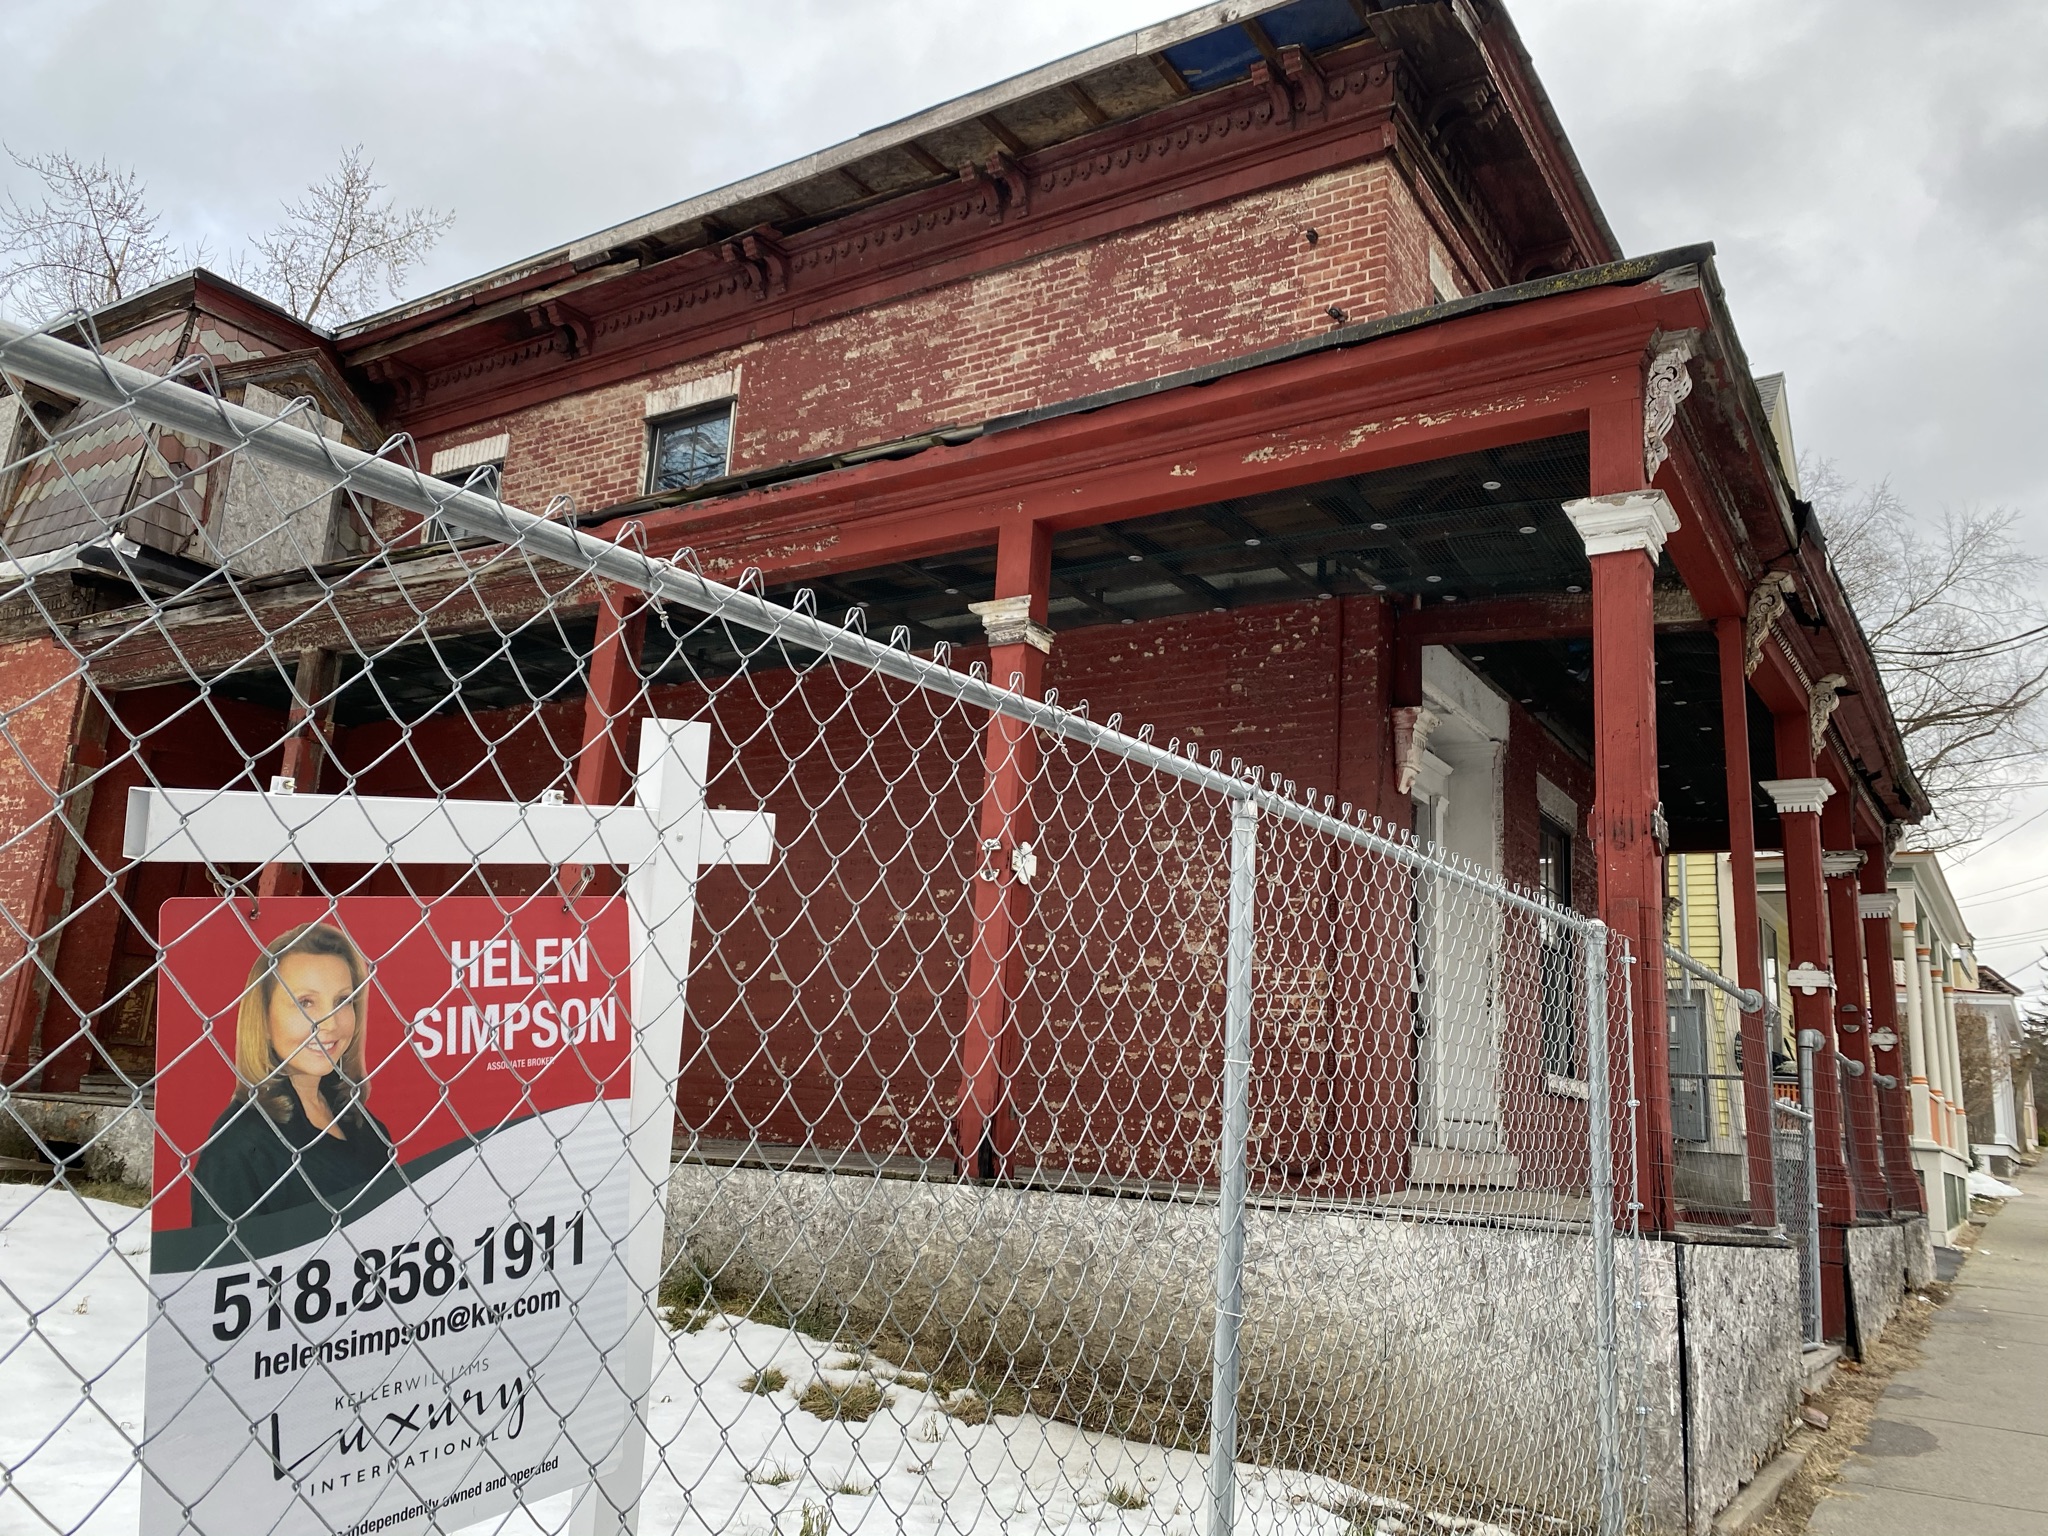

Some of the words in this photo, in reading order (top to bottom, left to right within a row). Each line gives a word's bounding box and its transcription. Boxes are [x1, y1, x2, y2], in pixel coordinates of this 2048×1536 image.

[451, 937, 589, 989] HELEN
[413, 997, 617, 1058] SIMPSON
[212, 1211, 584, 1341] 518.858.1911
[254, 1289, 561, 1379] helensimpson@kw.com
[271, 1377, 545, 1480] Luxury
[442, 1482, 483, 1507] owned
[485, 1475, 507, 1492] and
[509, 1456, 559, 1485] operated
